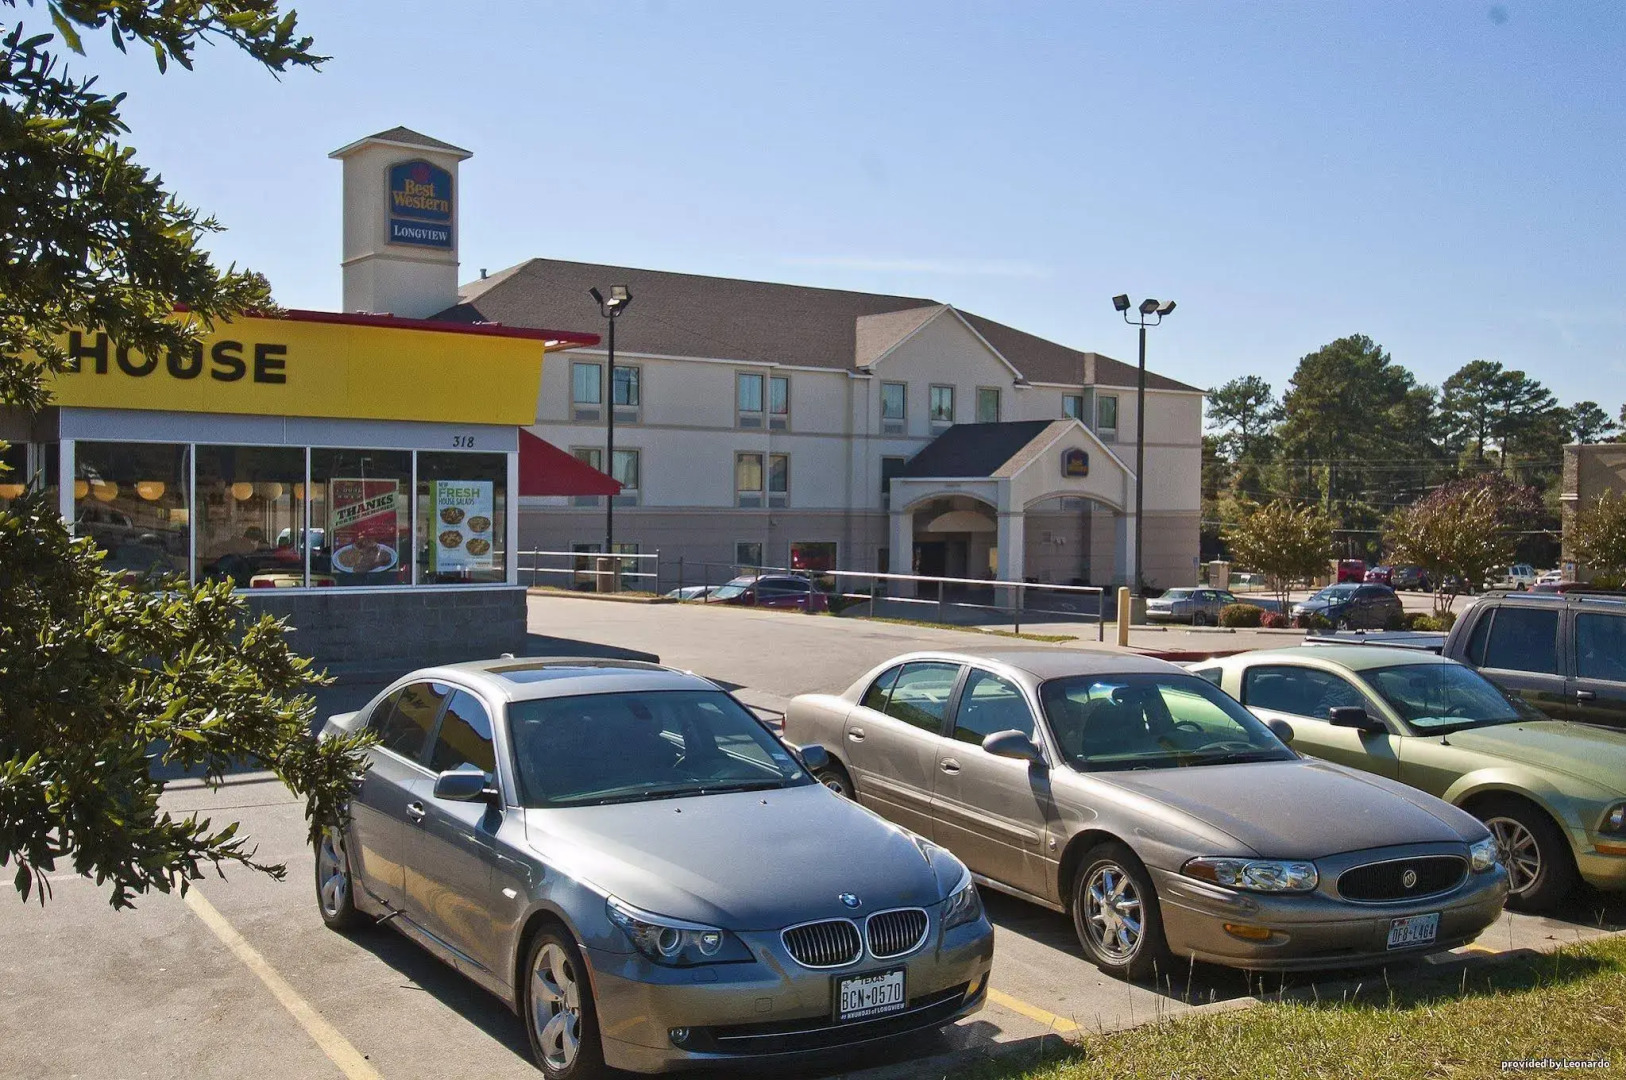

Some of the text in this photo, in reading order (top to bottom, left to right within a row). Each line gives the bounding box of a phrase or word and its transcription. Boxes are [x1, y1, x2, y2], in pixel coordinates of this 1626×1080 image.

[404, 179, 435, 197] Best
[392, 190, 449, 213] Western
[394, 225, 448, 241] LONGVIEW
[69, 330, 287, 384] HOUSE
[452, 436, 475, 448] 318
[438, 488, 480, 498] FRESH
[337, 494, 394, 520] THANKS
